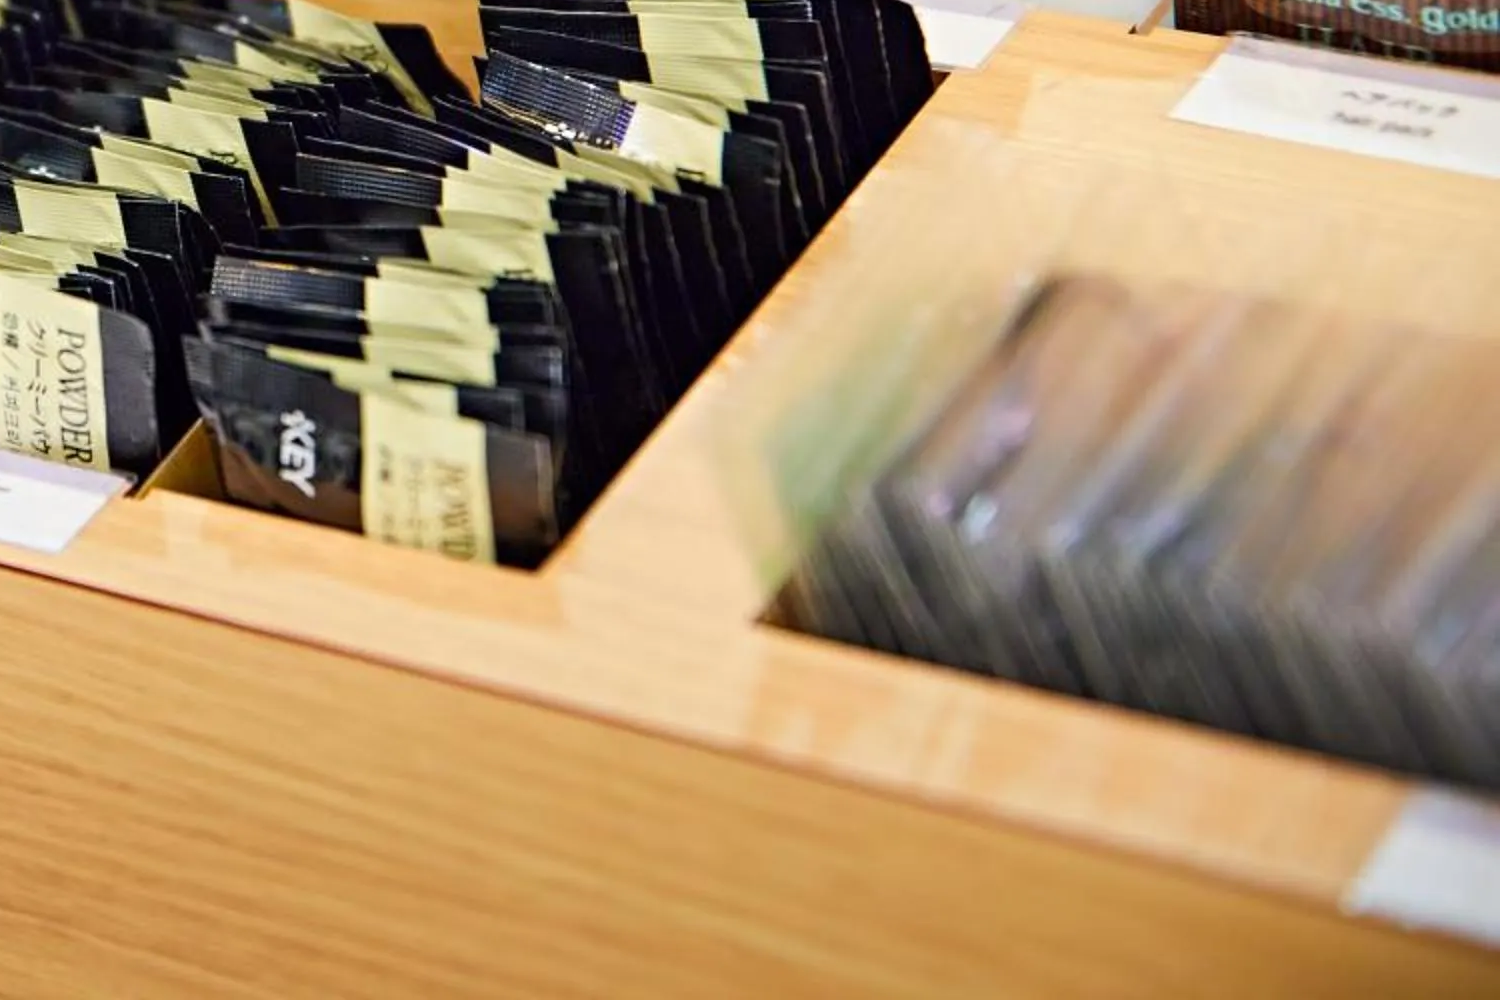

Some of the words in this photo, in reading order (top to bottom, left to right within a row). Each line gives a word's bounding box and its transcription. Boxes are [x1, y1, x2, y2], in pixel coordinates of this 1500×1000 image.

[1420, 4, 1500, 36] gold
[56, 327, 94, 465] POWDER
[278, 409, 317, 499] KEY
